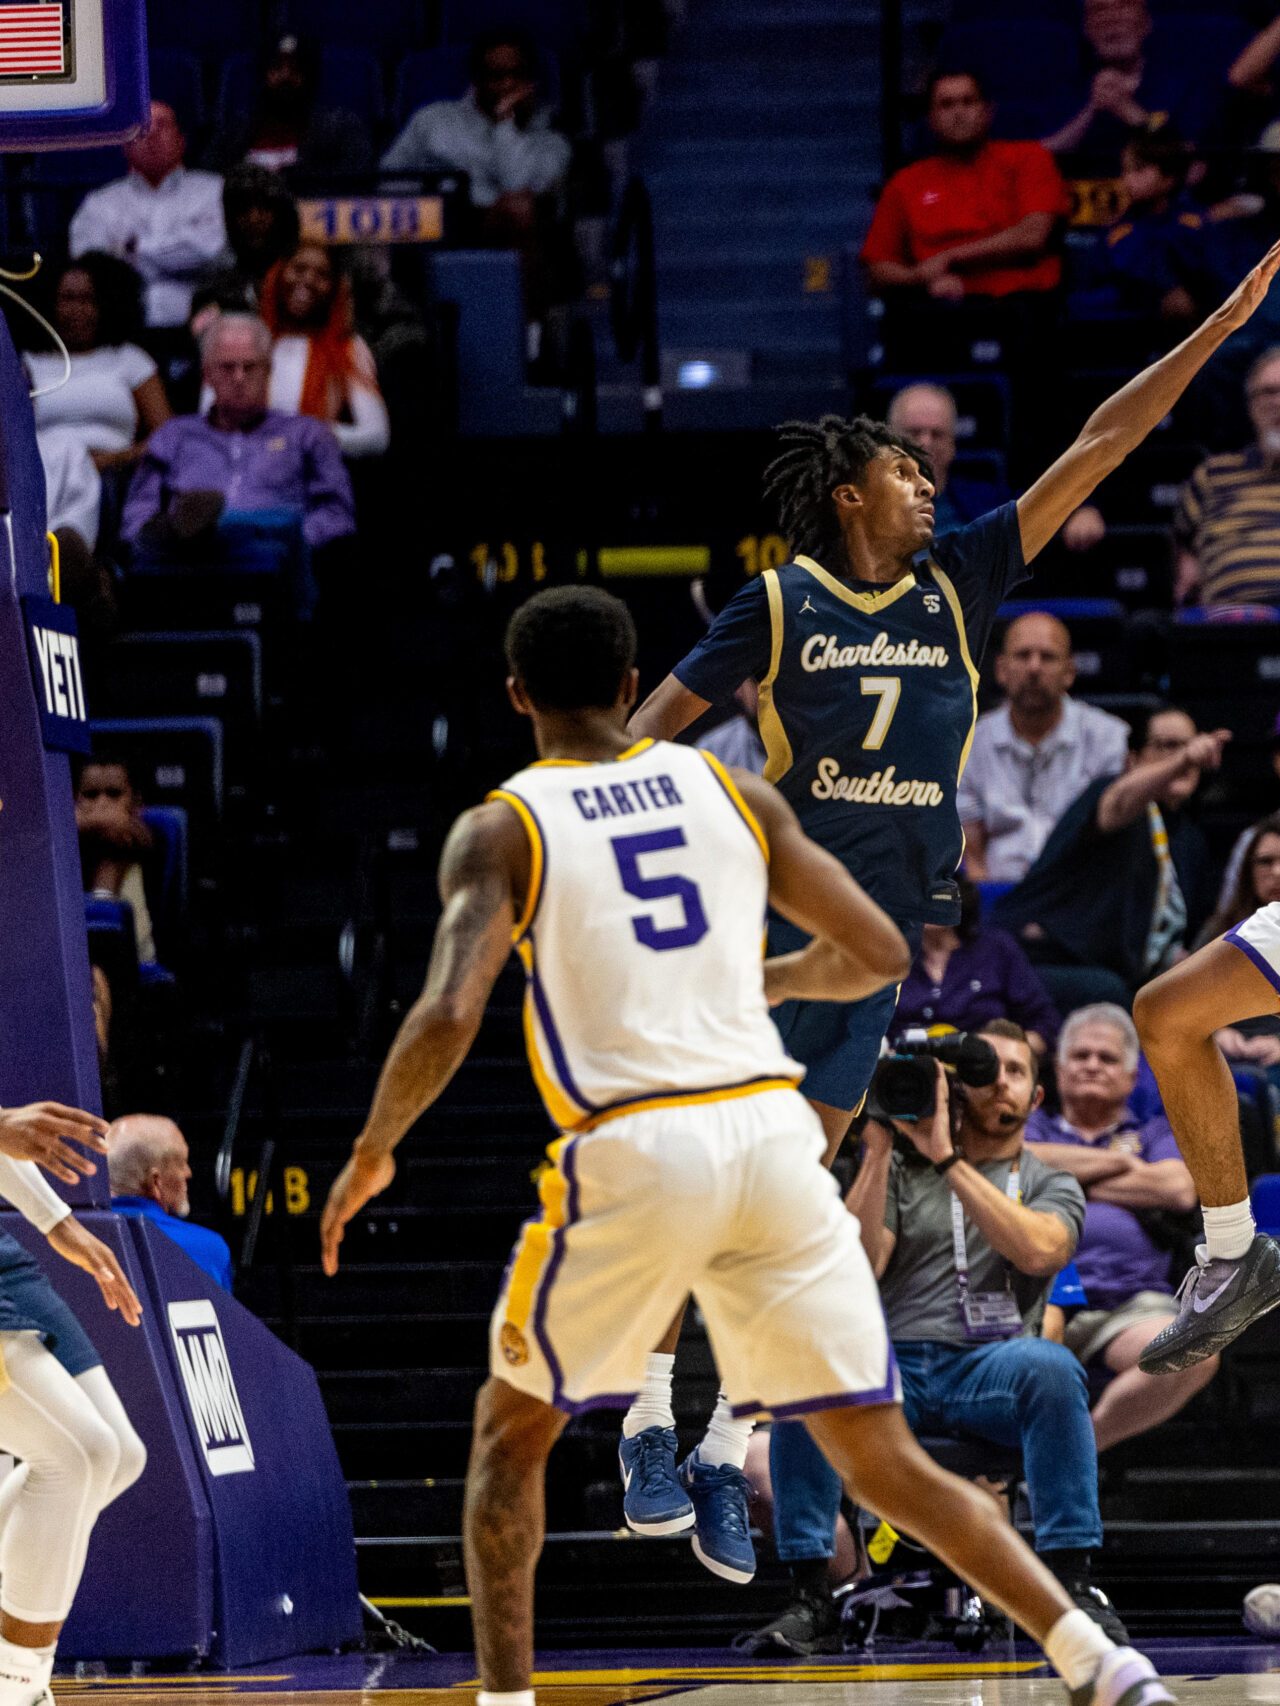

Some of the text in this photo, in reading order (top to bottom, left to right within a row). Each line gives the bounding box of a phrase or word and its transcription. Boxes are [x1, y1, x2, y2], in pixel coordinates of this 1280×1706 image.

[33, 624, 86, 722] YETI
[801, 631, 949, 673] Charleston
[859, 676, 902, 750] 7
[572, 773, 684, 821] CARTER
[811, 757, 944, 807] Southern
[610, 825, 711, 952] 5
